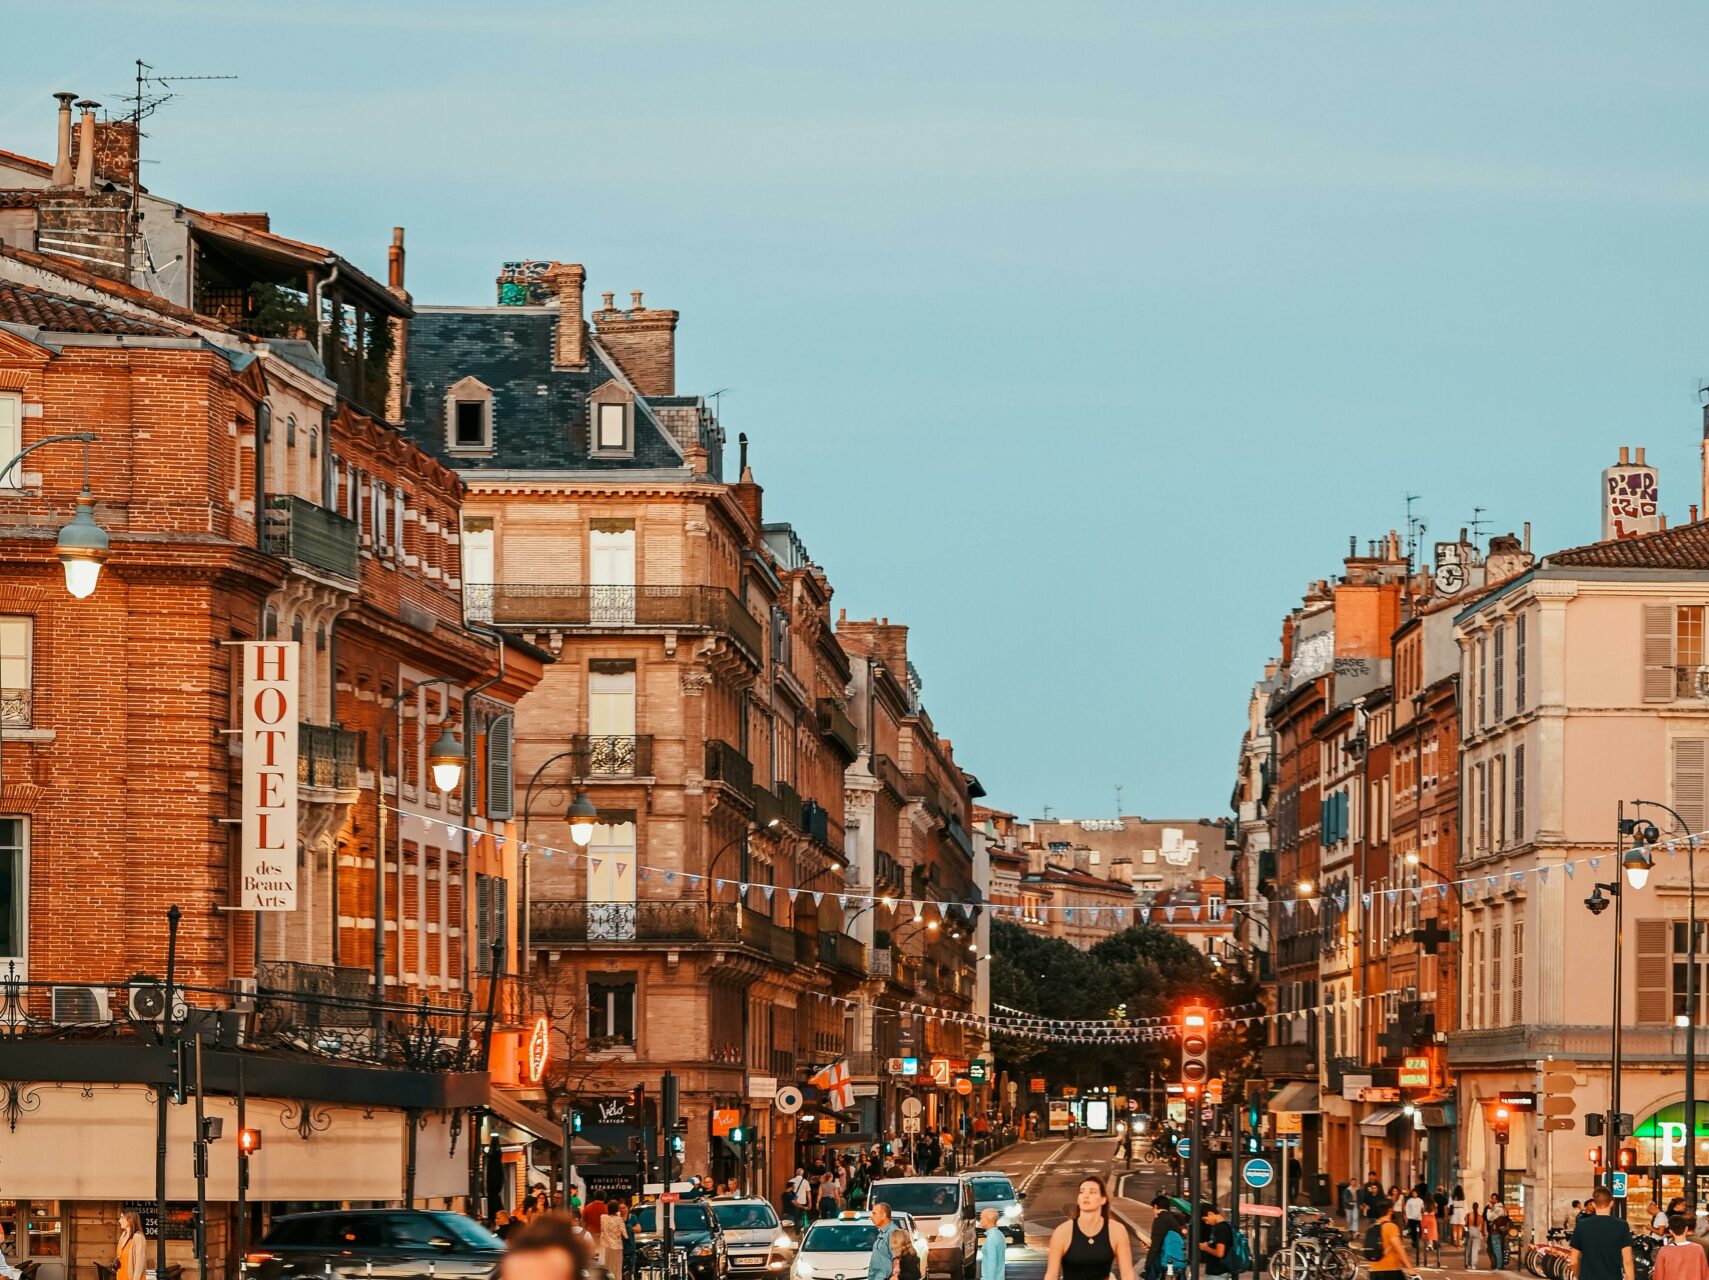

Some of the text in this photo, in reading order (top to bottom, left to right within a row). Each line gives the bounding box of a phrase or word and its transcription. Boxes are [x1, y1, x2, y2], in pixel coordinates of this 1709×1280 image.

[252, 645, 289, 850] HOTEL
[255, 860, 282, 875] des
[244, 876, 293, 891] Beaux
[252, 893, 286, 908] Arts
